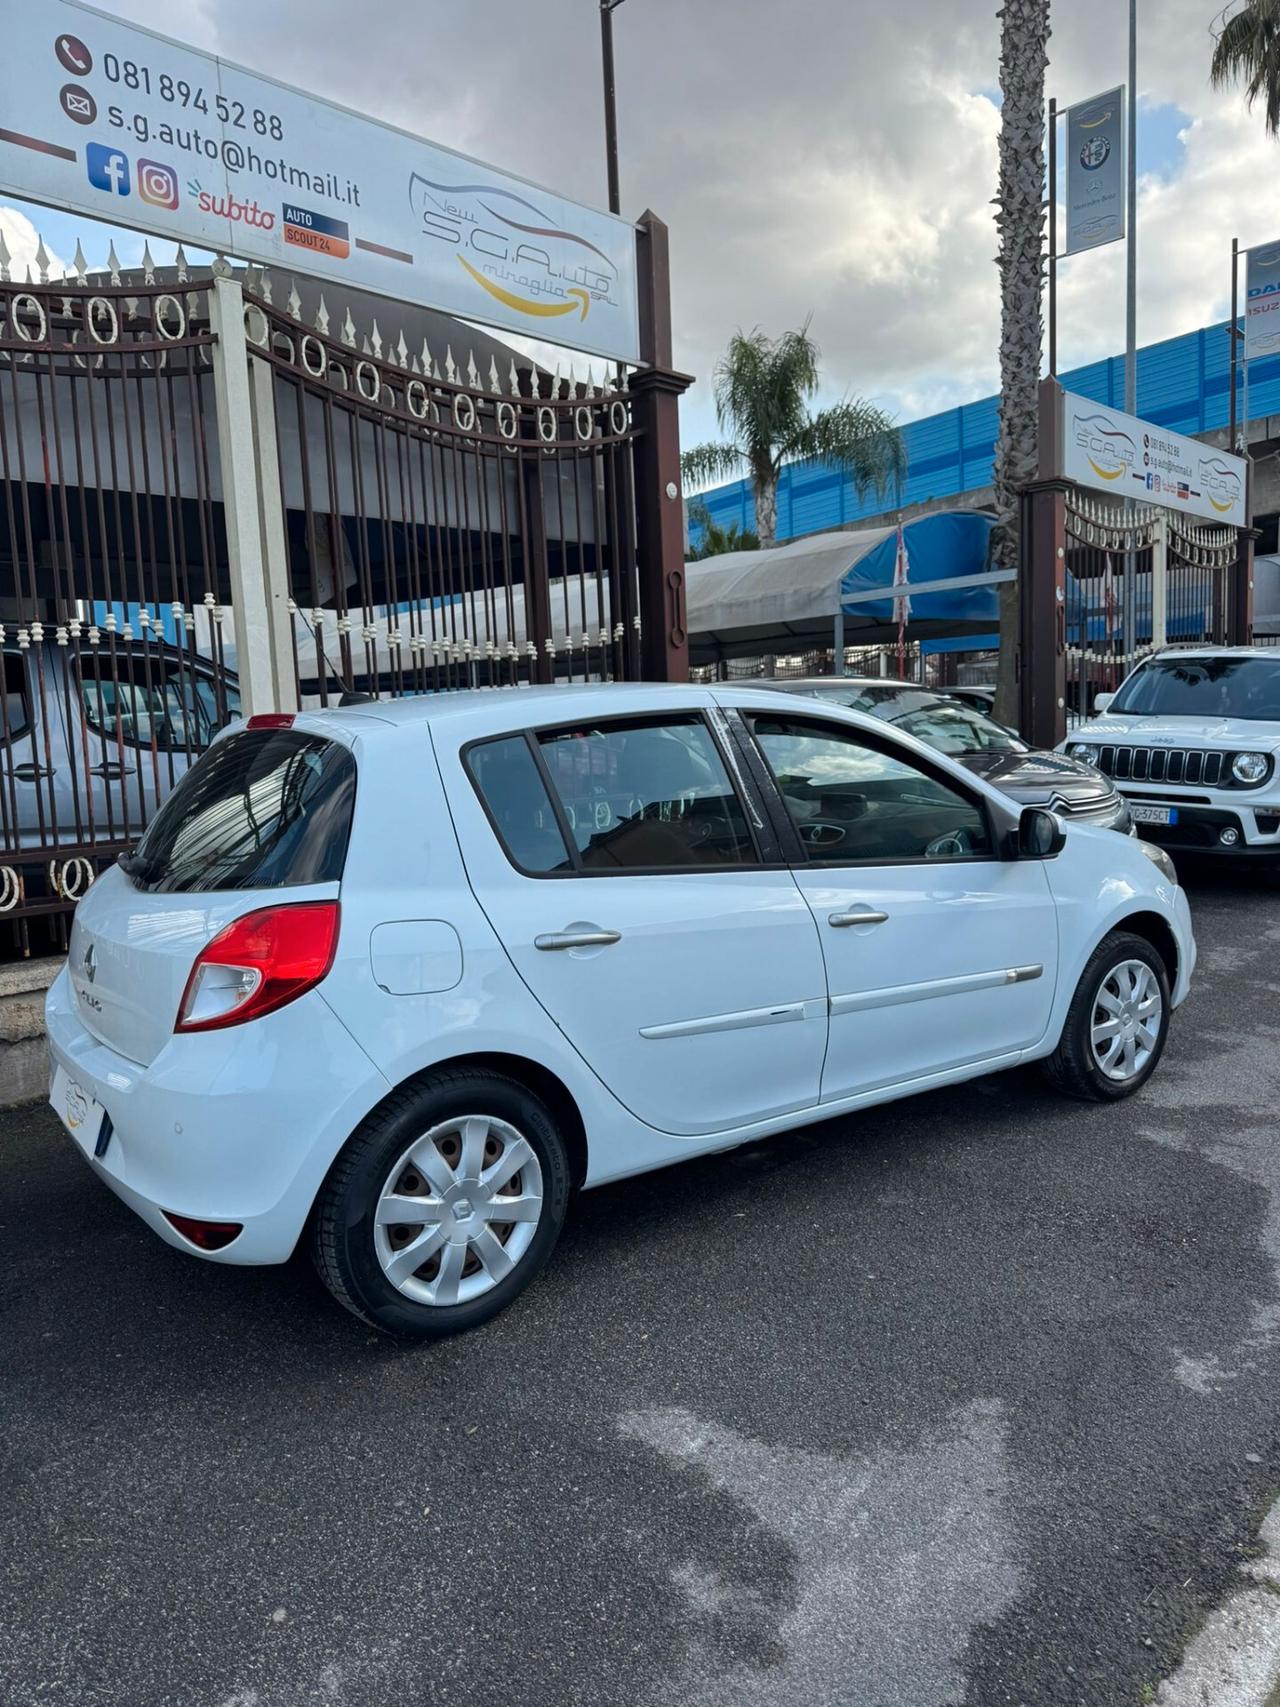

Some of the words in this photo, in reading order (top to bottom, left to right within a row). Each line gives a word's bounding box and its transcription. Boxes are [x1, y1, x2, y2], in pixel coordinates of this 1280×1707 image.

[103, 53, 151, 95] 081
[159, 74, 208, 115] 894
[108, 105, 361, 208] s.g.auto@hotmail.it
[197, 190, 276, 232] subito
[286, 208, 313, 226] AUTO
